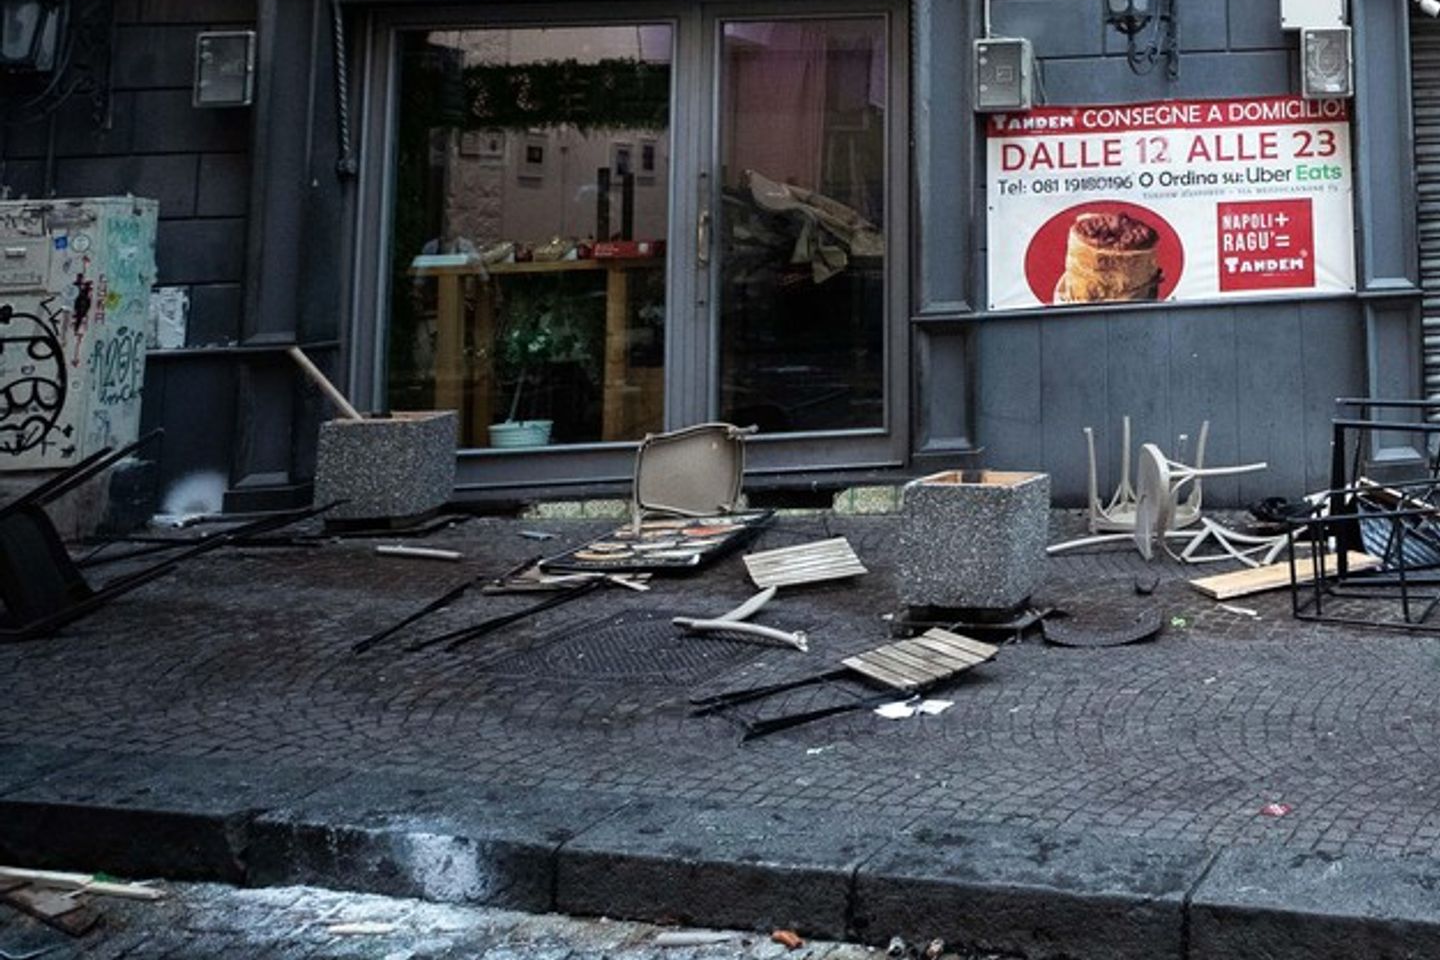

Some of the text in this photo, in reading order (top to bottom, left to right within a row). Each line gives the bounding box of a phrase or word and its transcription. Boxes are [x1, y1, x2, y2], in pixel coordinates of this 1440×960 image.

[993, 98, 1346, 130] TANDEM CONSEGNE A DOMICILIO!
[1001, 129, 1337, 171] DALLE 12 ALLE 23
[998, 178, 1027, 196] Tel:
[1032, 178, 1060, 194] 081
[1138, 171, 1154, 188] O
[1159, 169, 1218, 187] Ordina
[1222, 172, 1244, 185] su:
[1246, 166, 1292, 184] Uber
[1295, 164, 1342, 182] Eats
[1224, 256, 1304, 274] TANDEM
